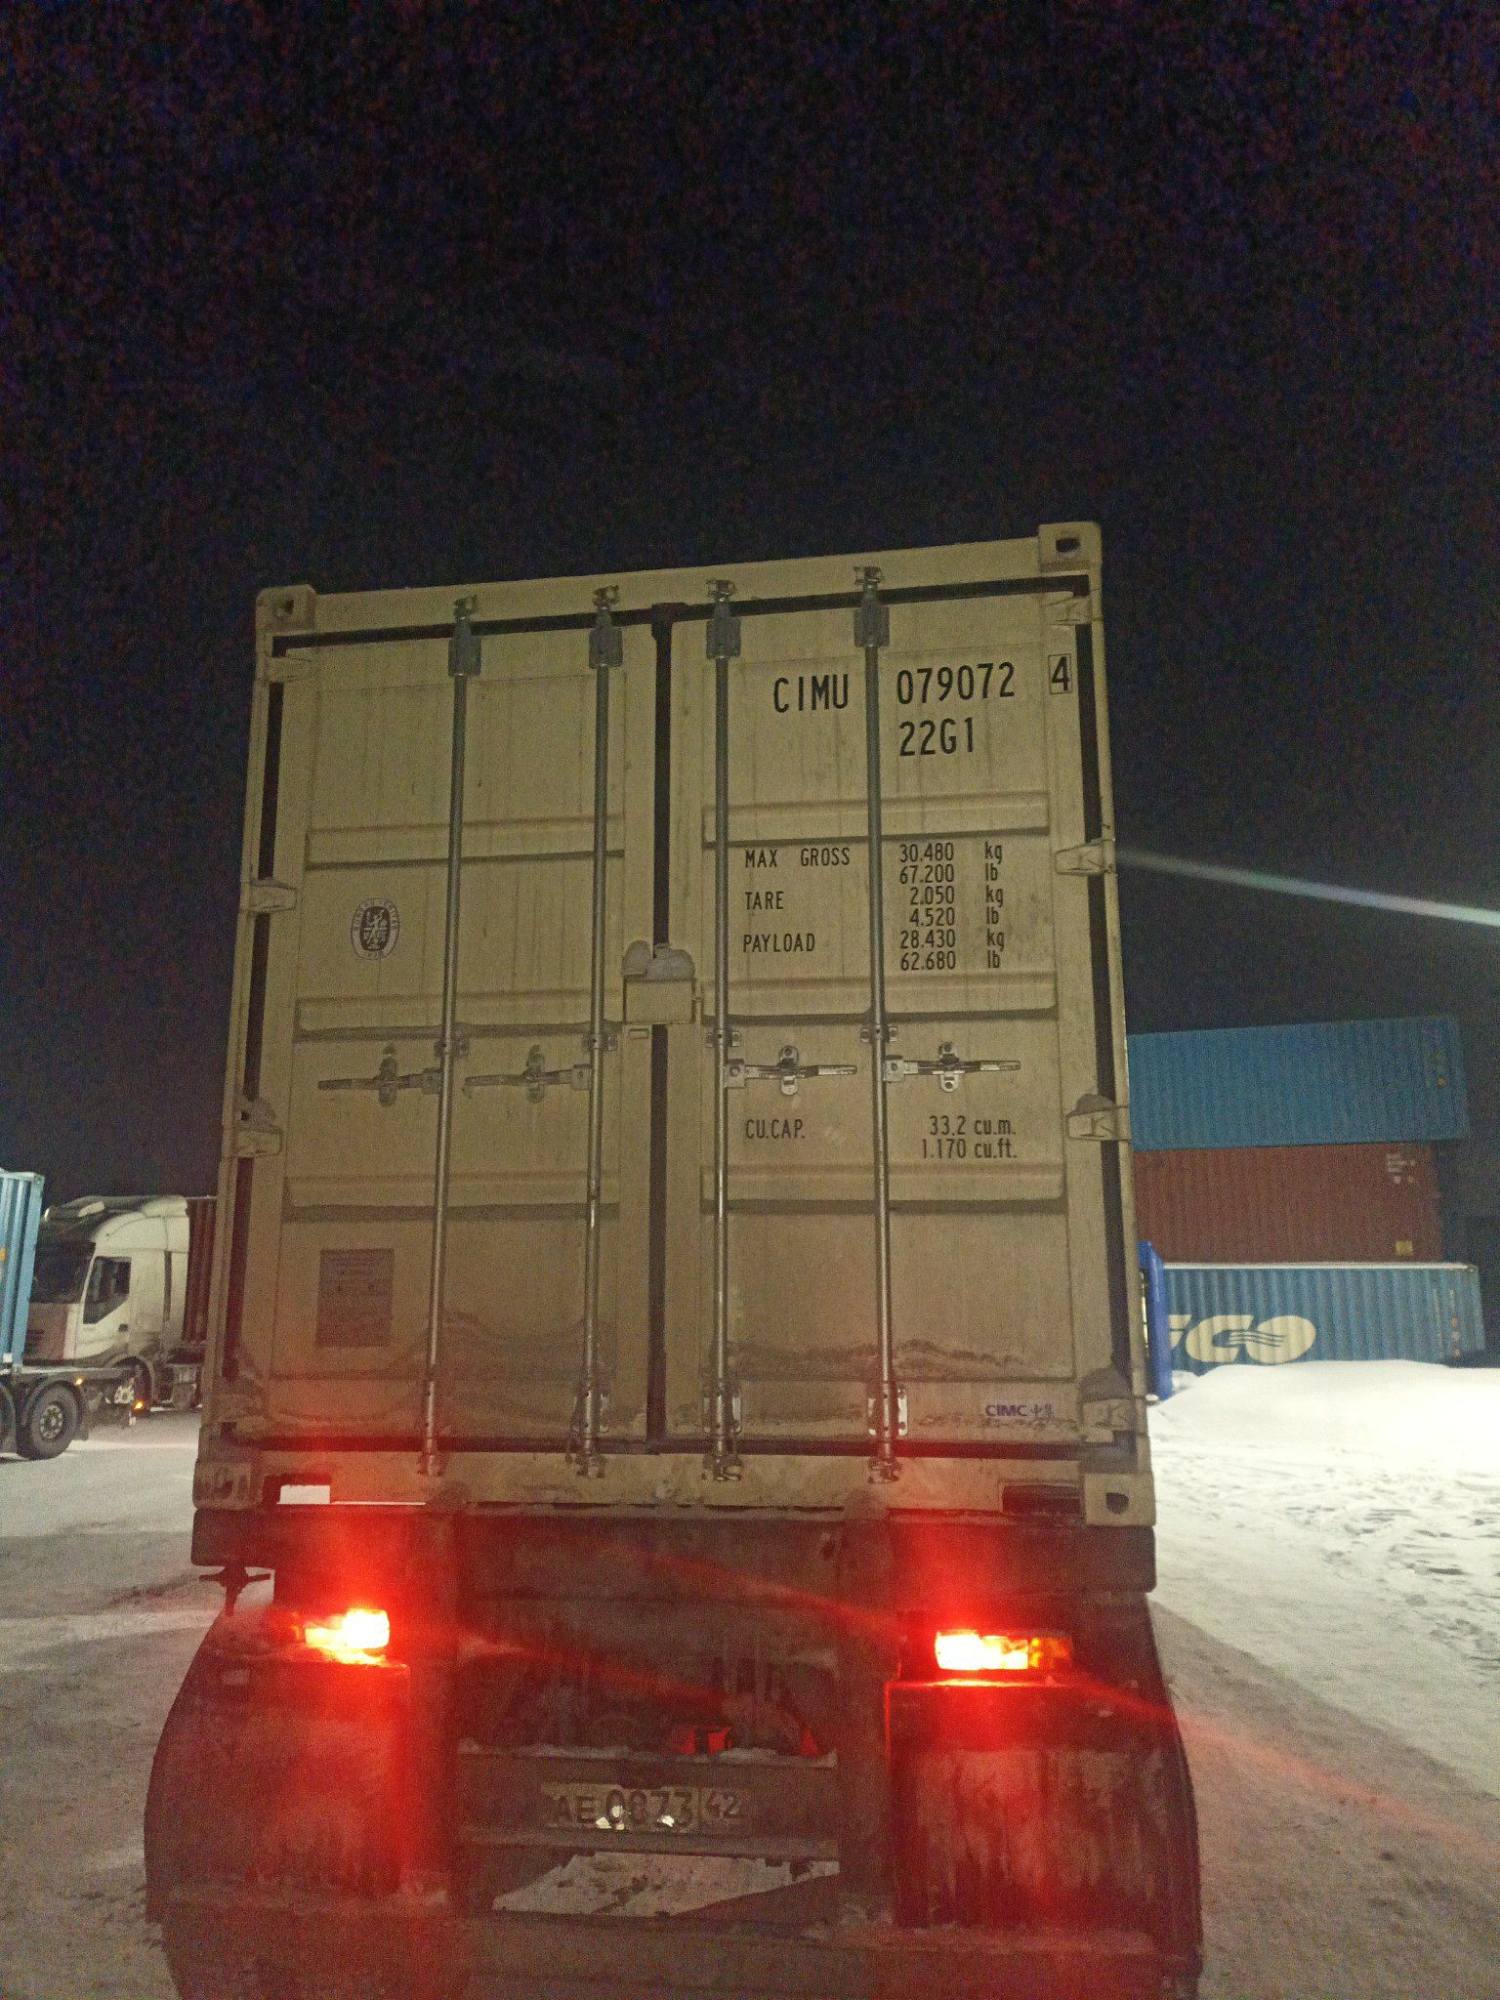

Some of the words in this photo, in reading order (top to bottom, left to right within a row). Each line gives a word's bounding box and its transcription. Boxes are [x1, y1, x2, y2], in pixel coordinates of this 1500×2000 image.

[773, 673, 849, 713] CIMU
[896, 661, 1016, 705] 079072
[1050, 656, 1071, 692] 4
[899, 716, 974, 757] 22G1
[745, 848, 778, 868] MAX
[800, 847, 850, 867] GROSS
[899, 842, 955, 862] 30.480
[985, 841, 1003, 864] kg
[899, 863, 955, 884] 67.200
[985, 863, 998, 881] lb
[745, 891, 784, 910] TARE
[910, 885, 955, 905] 2.050
[986, 885, 1004, 908] kg
[909, 907, 956, 927] 4.520
[986, 907, 999, 925] lb
[742, 932, 816, 953] PAYLOAD
[900, 929, 956, 949] 28.430
[987, 928, 1005, 952] kg
[900, 951, 957, 971] 62.680
[987, 950, 1001, 968] lb
[745, 1119, 805, 1139] CU.CAP.
[929, 1115, 966, 1136] 33.2
[922, 1138, 967, 1159] 1.170
[974, 1138, 1018, 1158] cu.ft.
[985, 1403, 1028, 1417] CIMC
